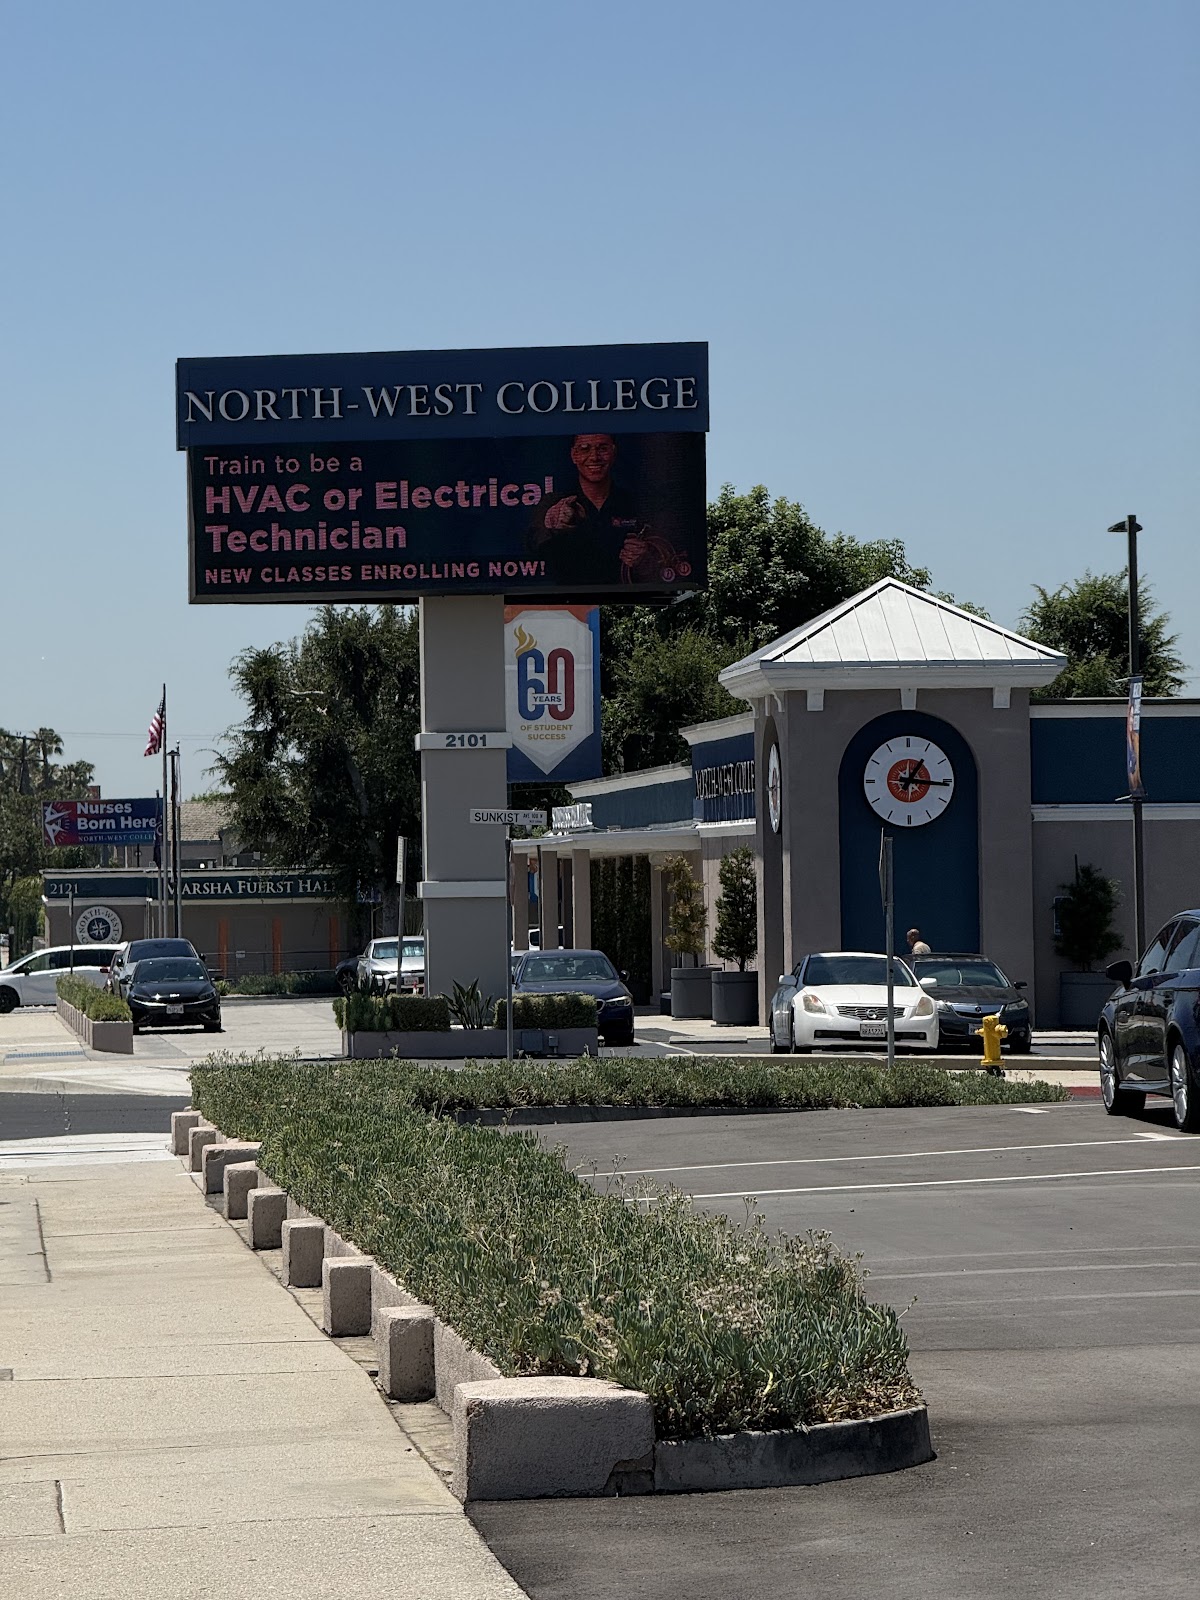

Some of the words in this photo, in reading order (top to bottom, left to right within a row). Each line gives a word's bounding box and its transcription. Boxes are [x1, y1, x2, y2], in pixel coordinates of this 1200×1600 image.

[184, 383, 482, 422] NORTH-WEST
[496, 378, 698, 414] COLLEGE
[204, 455, 265, 475] Train
[275, 455, 300, 473] to
[310, 453, 340, 472] be
[349, 456, 363, 472] a
[205, 484, 310, 514] HVAC
[323, 488, 362, 511] or
[205, 521, 407, 553] Technician
[205, 568, 252, 584] NEW
[260, 565, 352, 583] CLASSES
[361, 562, 480, 581] ENROLLING
[488, 560, 545, 577] NOW!
[517, 648, 575, 721] 60
[445, 734, 487, 747] 2101
[76, 802, 133, 815] Nurses
[474, 812, 519, 822] SUNKIST
[77, 817, 116, 830] Born
[50, 883, 78, 895] 2121
[237, 880, 294, 895] FUERST
[79, 908, 120, 934] NORTH-WEST
